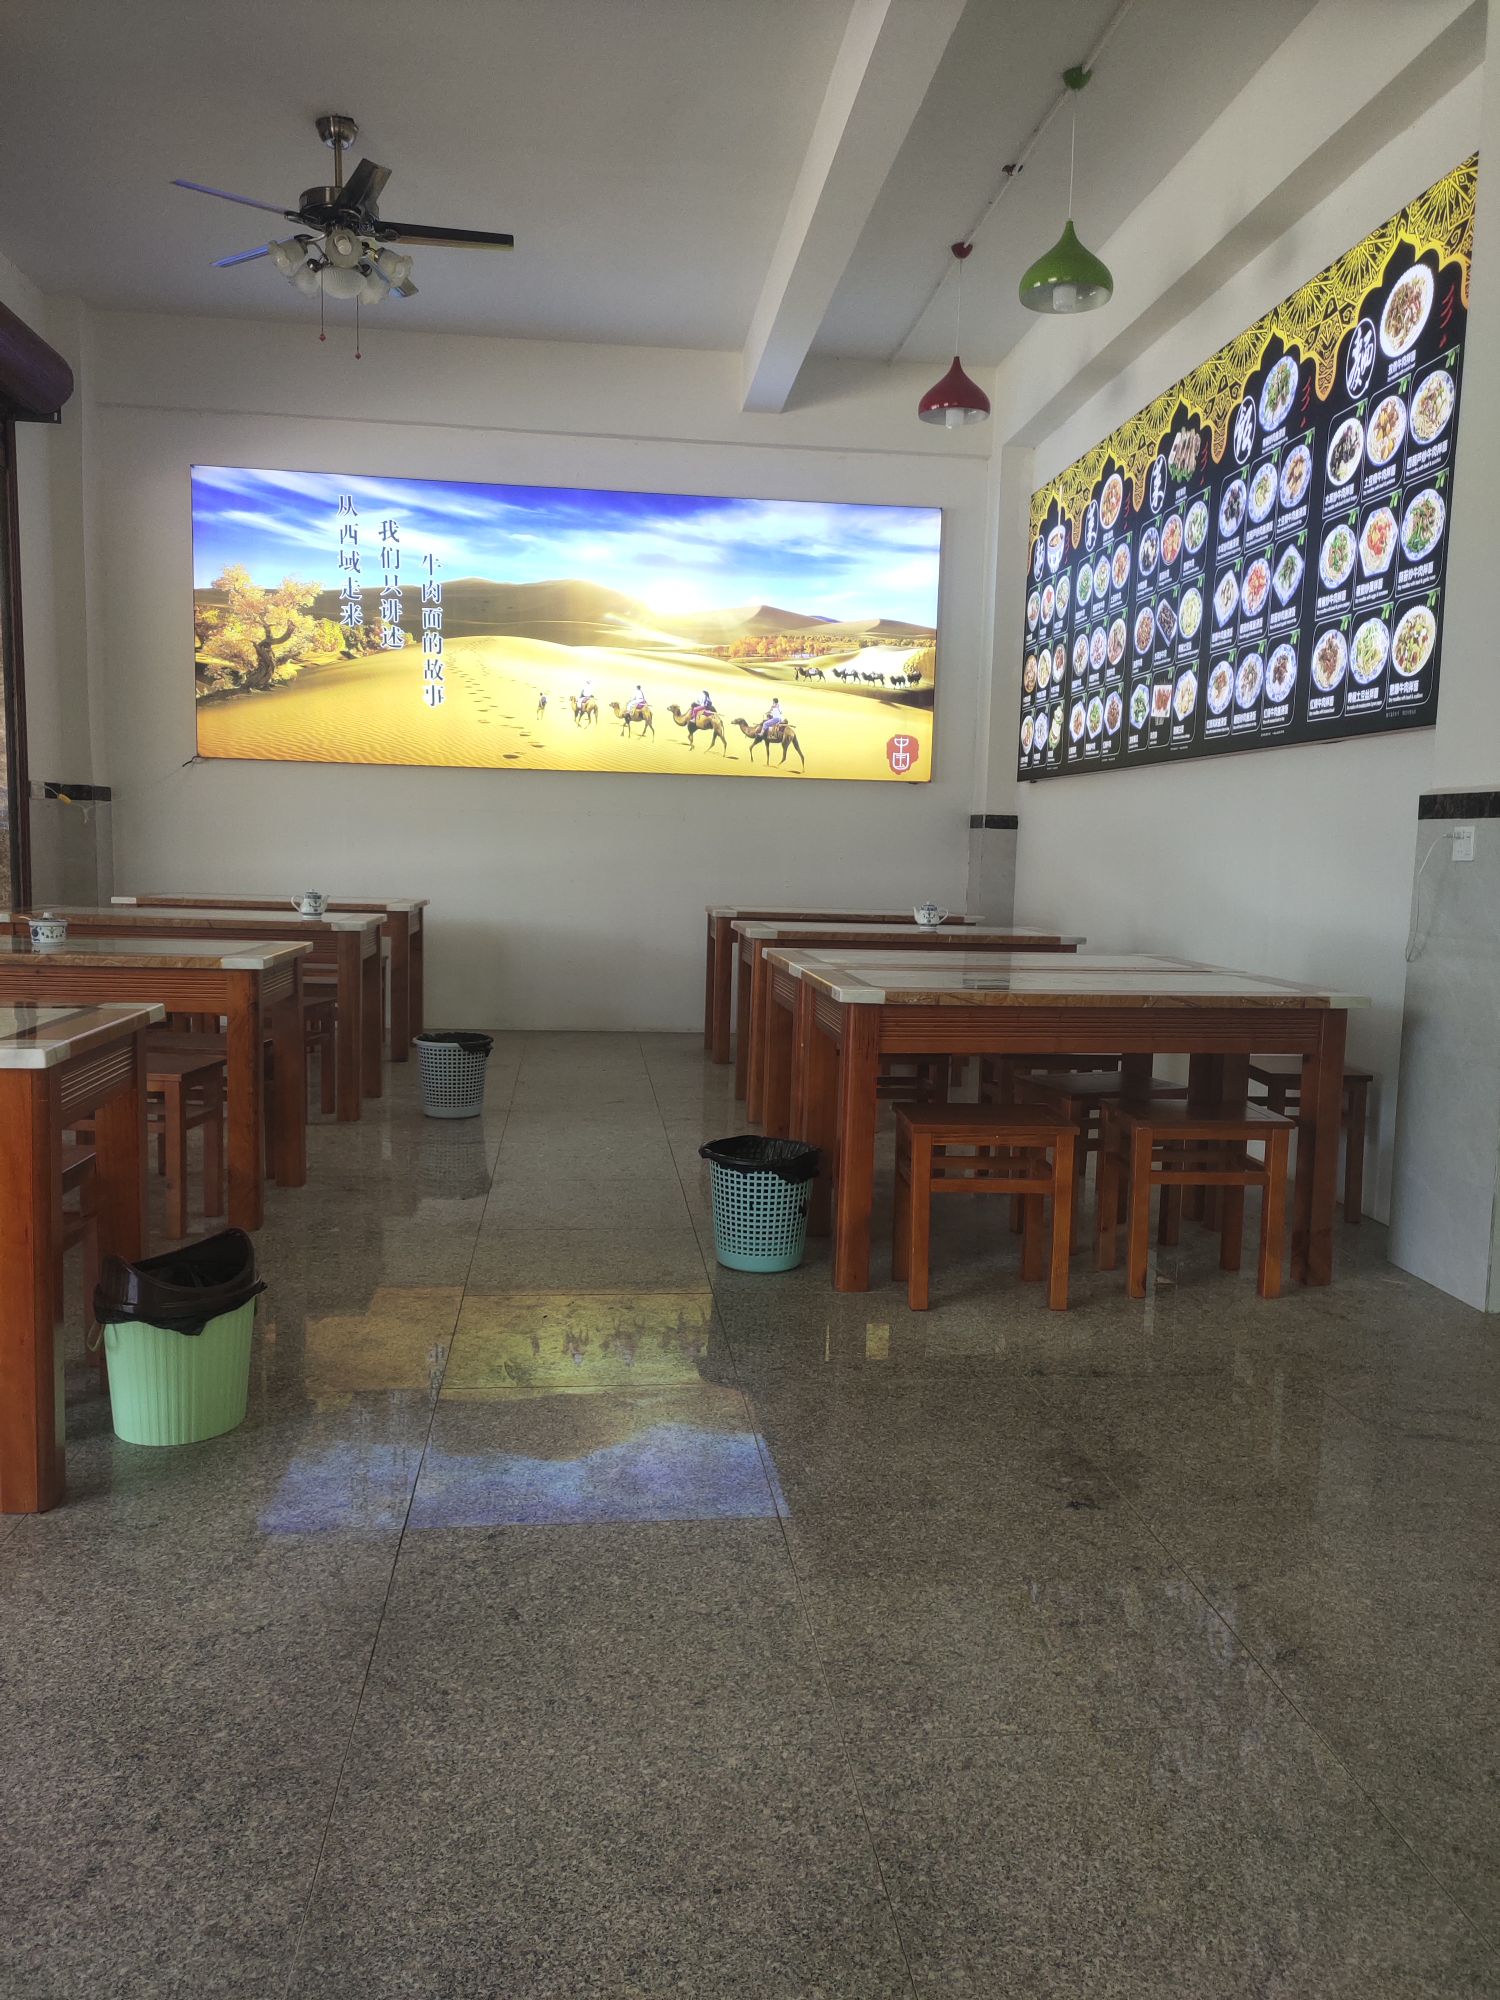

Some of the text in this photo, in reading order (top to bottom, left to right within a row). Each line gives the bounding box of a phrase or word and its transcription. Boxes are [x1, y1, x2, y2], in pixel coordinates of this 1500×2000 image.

[337, 495, 363, 626] 从西域走来
[378, 518, 405, 650] 我们只讲述
[421, 553, 445, 708] 牛肉面的故事
